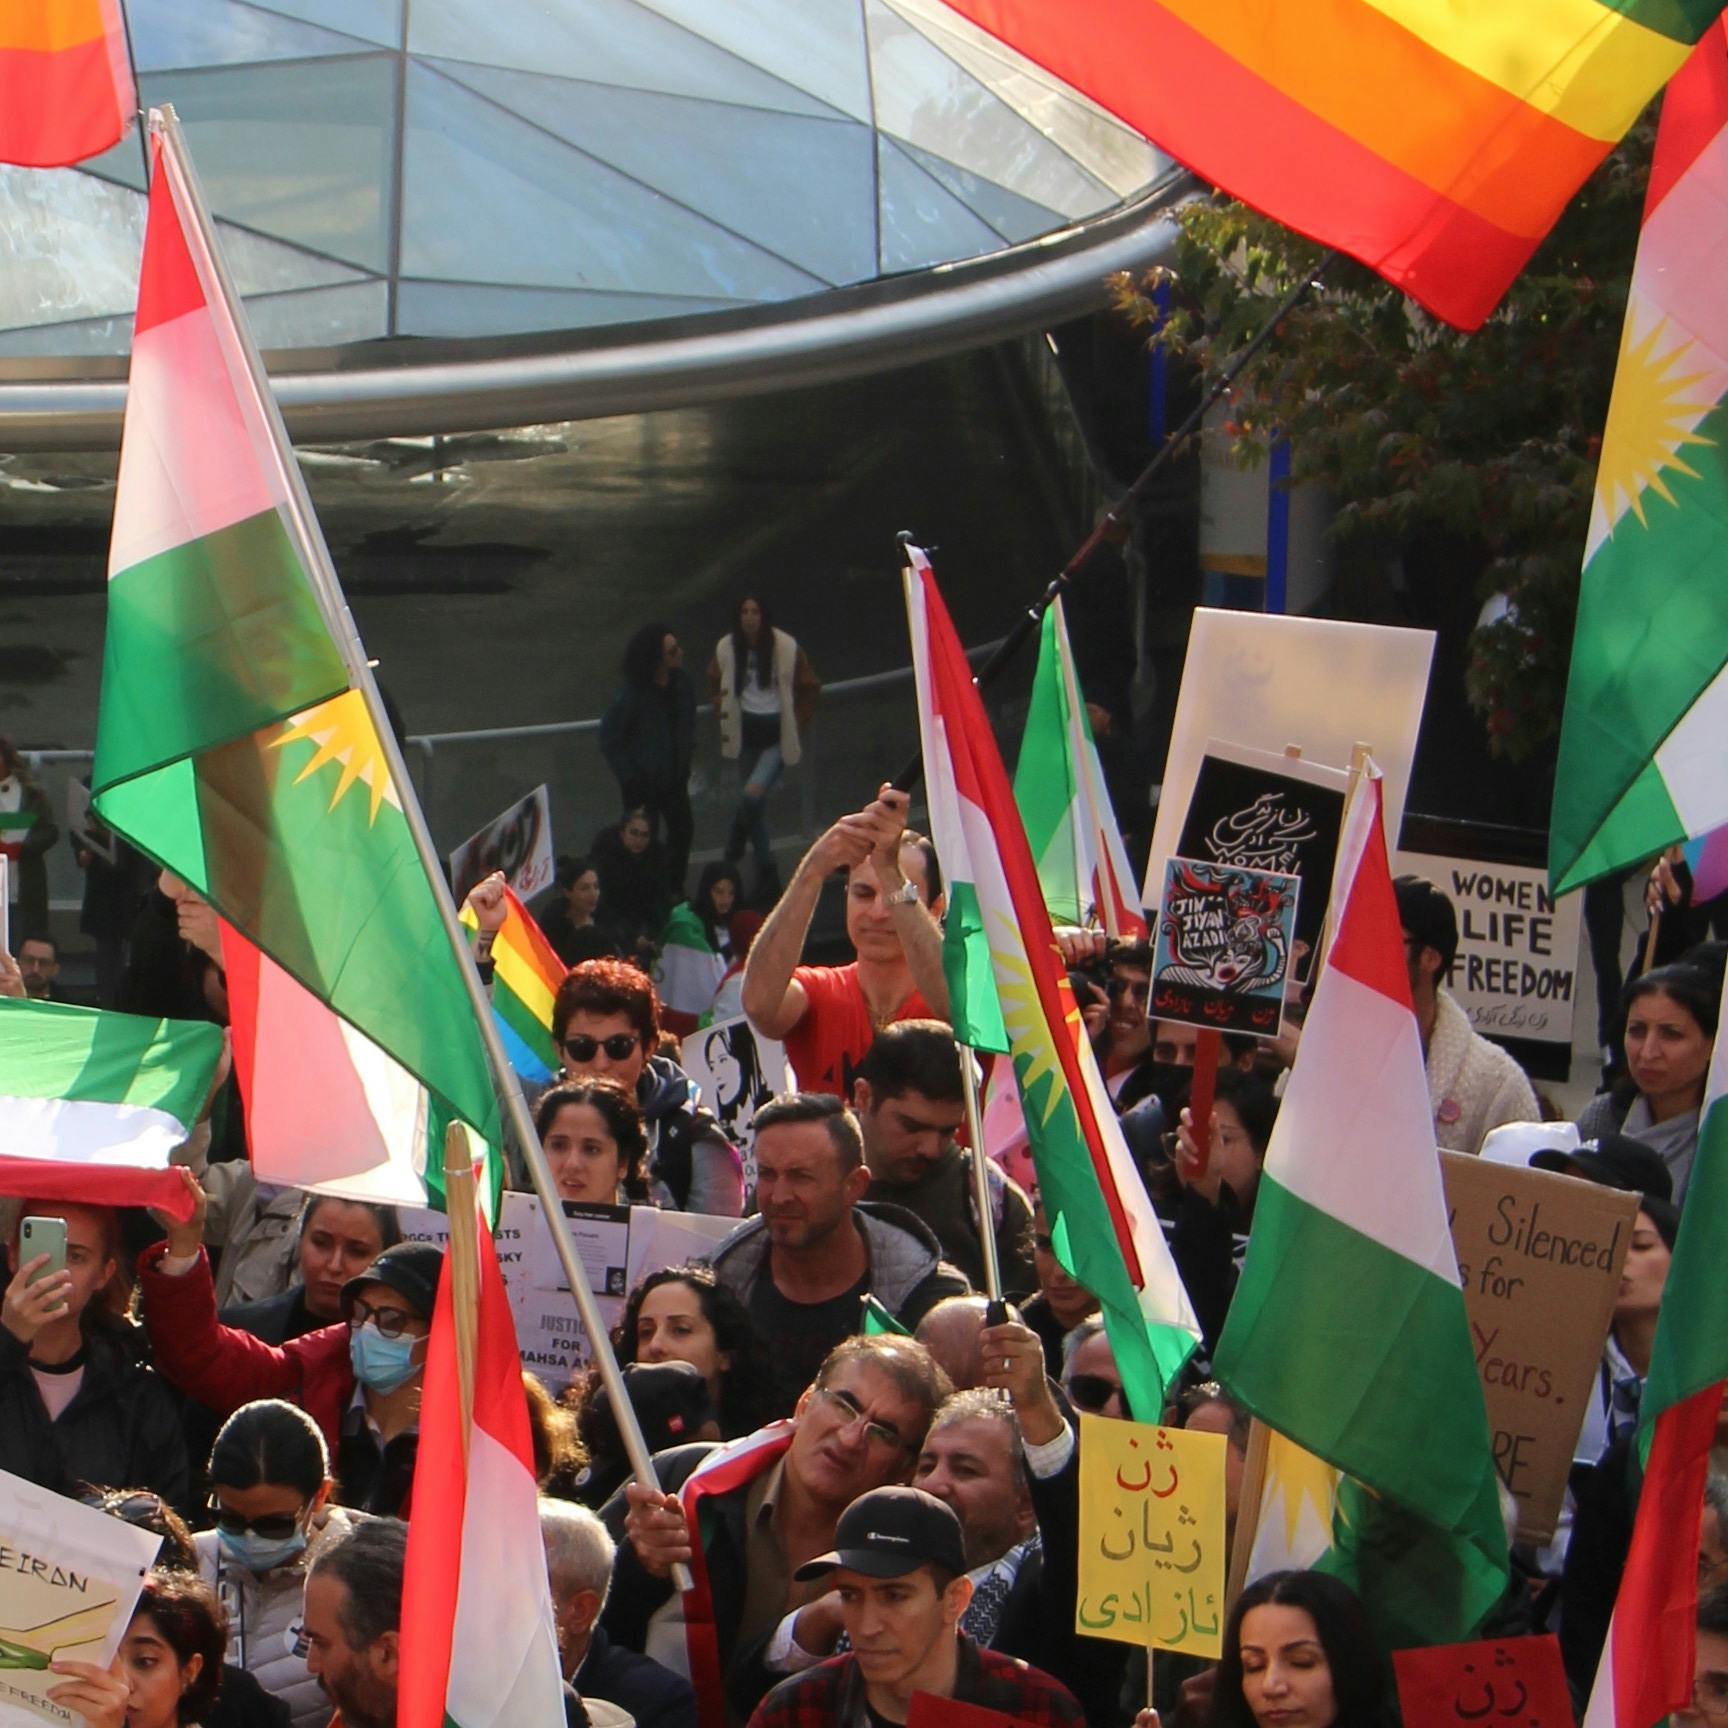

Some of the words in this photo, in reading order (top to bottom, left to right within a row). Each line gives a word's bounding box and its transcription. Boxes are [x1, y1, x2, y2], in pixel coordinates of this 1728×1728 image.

[1452, 870, 1556, 914] WOMEN
[1463, 909, 1553, 956] LIFE
[1446, 953, 1573, 1001] FREEDOM
[1488, 1194, 1622, 1274] Silenced
[1480, 1256, 1525, 1299] for
[552, 1338, 580, 1352] FOR
[1116, 1429, 1179, 1498] ژن
[1100, 1499, 1203, 1573] ژیان
[1454, 1647, 1528, 1719] ژن
